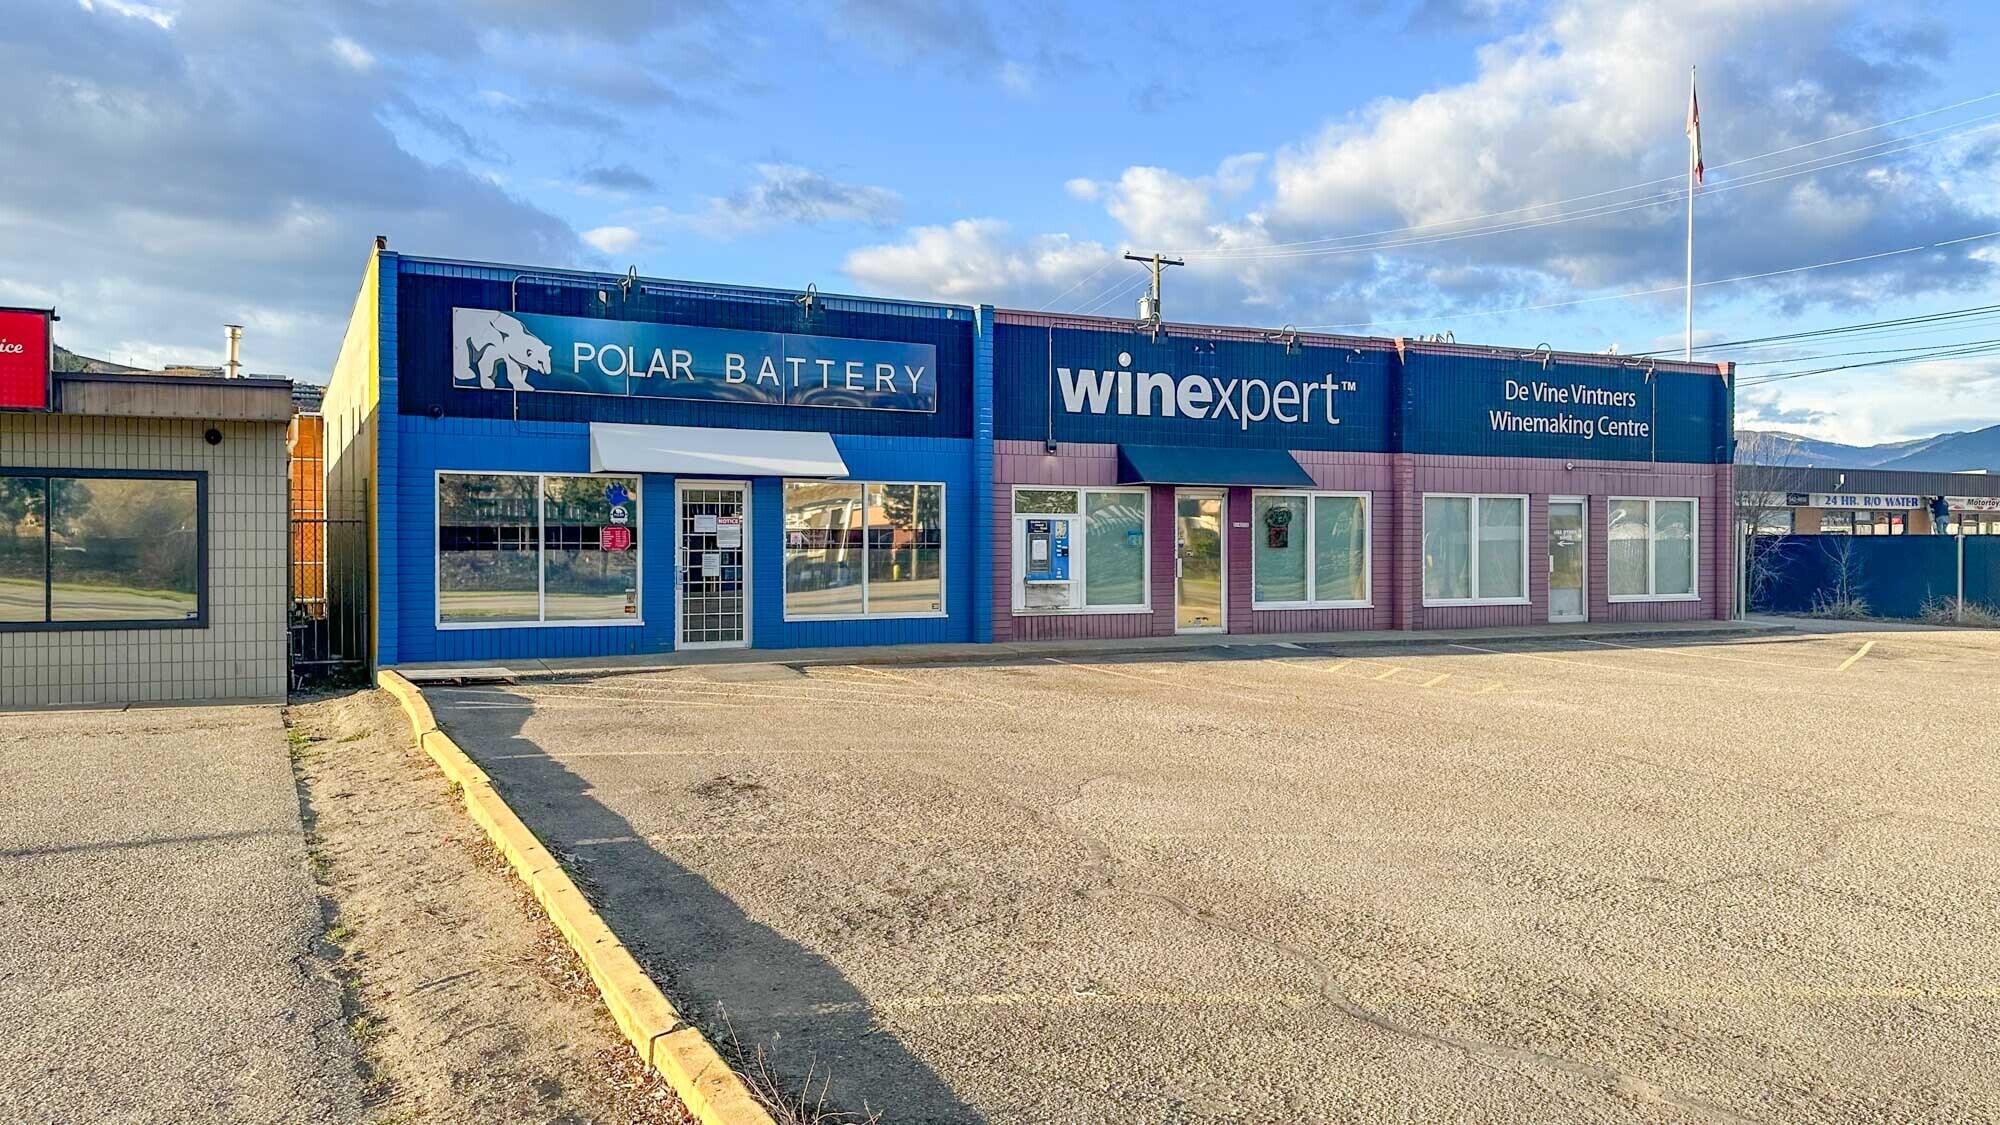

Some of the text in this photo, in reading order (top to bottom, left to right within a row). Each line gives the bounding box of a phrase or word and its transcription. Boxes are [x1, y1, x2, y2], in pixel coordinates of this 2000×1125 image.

[573, 341, 926, 394] POLAR BATTERY
[1505, 380, 1636, 408] De Vine Vintners
[1489, 410, 1649, 440] Winemaking Centre
[1824, 495, 1838, 505] 24
[1863, 496, 1882, 507] R/O
[1885, 497, 1919, 507] WATER
[1966, 498, 2000, 508] Motortoy
